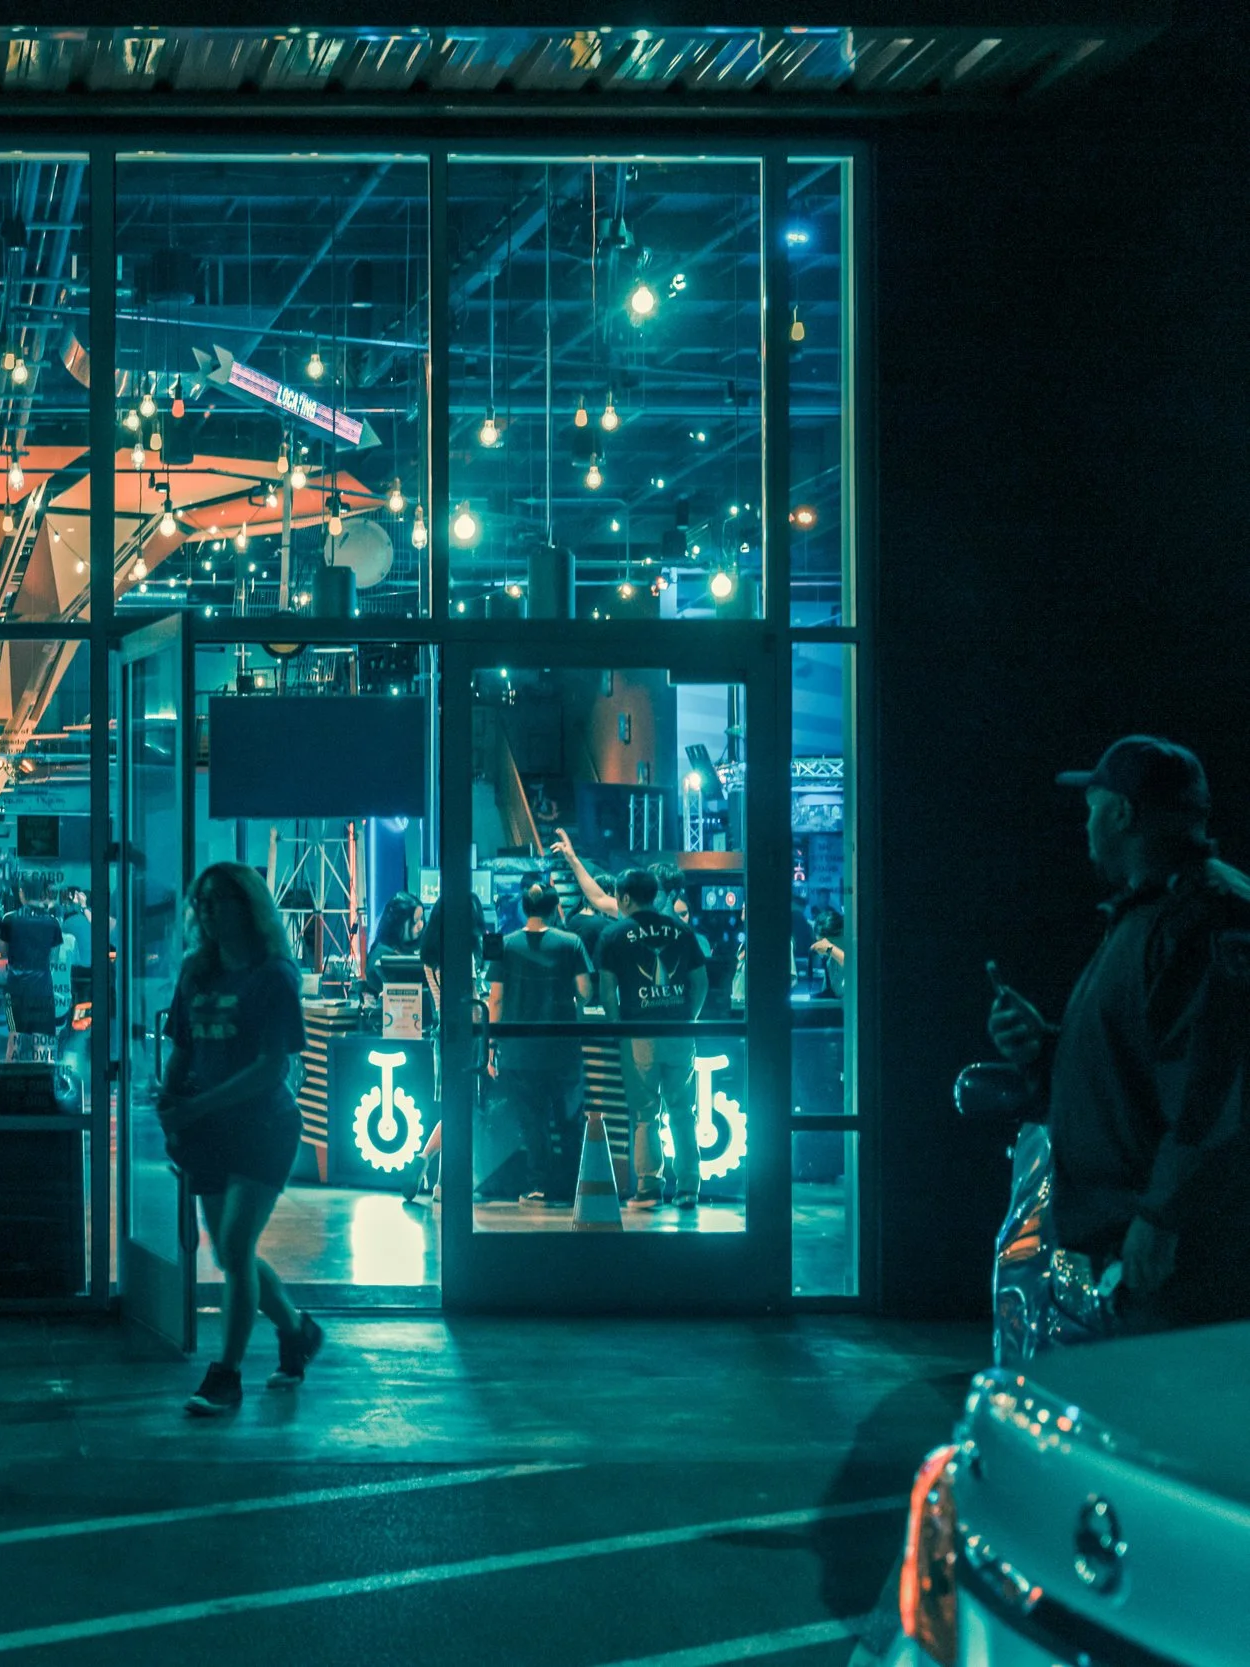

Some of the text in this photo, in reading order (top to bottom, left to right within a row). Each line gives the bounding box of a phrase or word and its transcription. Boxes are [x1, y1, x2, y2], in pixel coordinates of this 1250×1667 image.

[276, 384, 317, 419] LOCATING
[626, 924, 682, 943] SALTY
[638, 984, 685, 999] CREW
